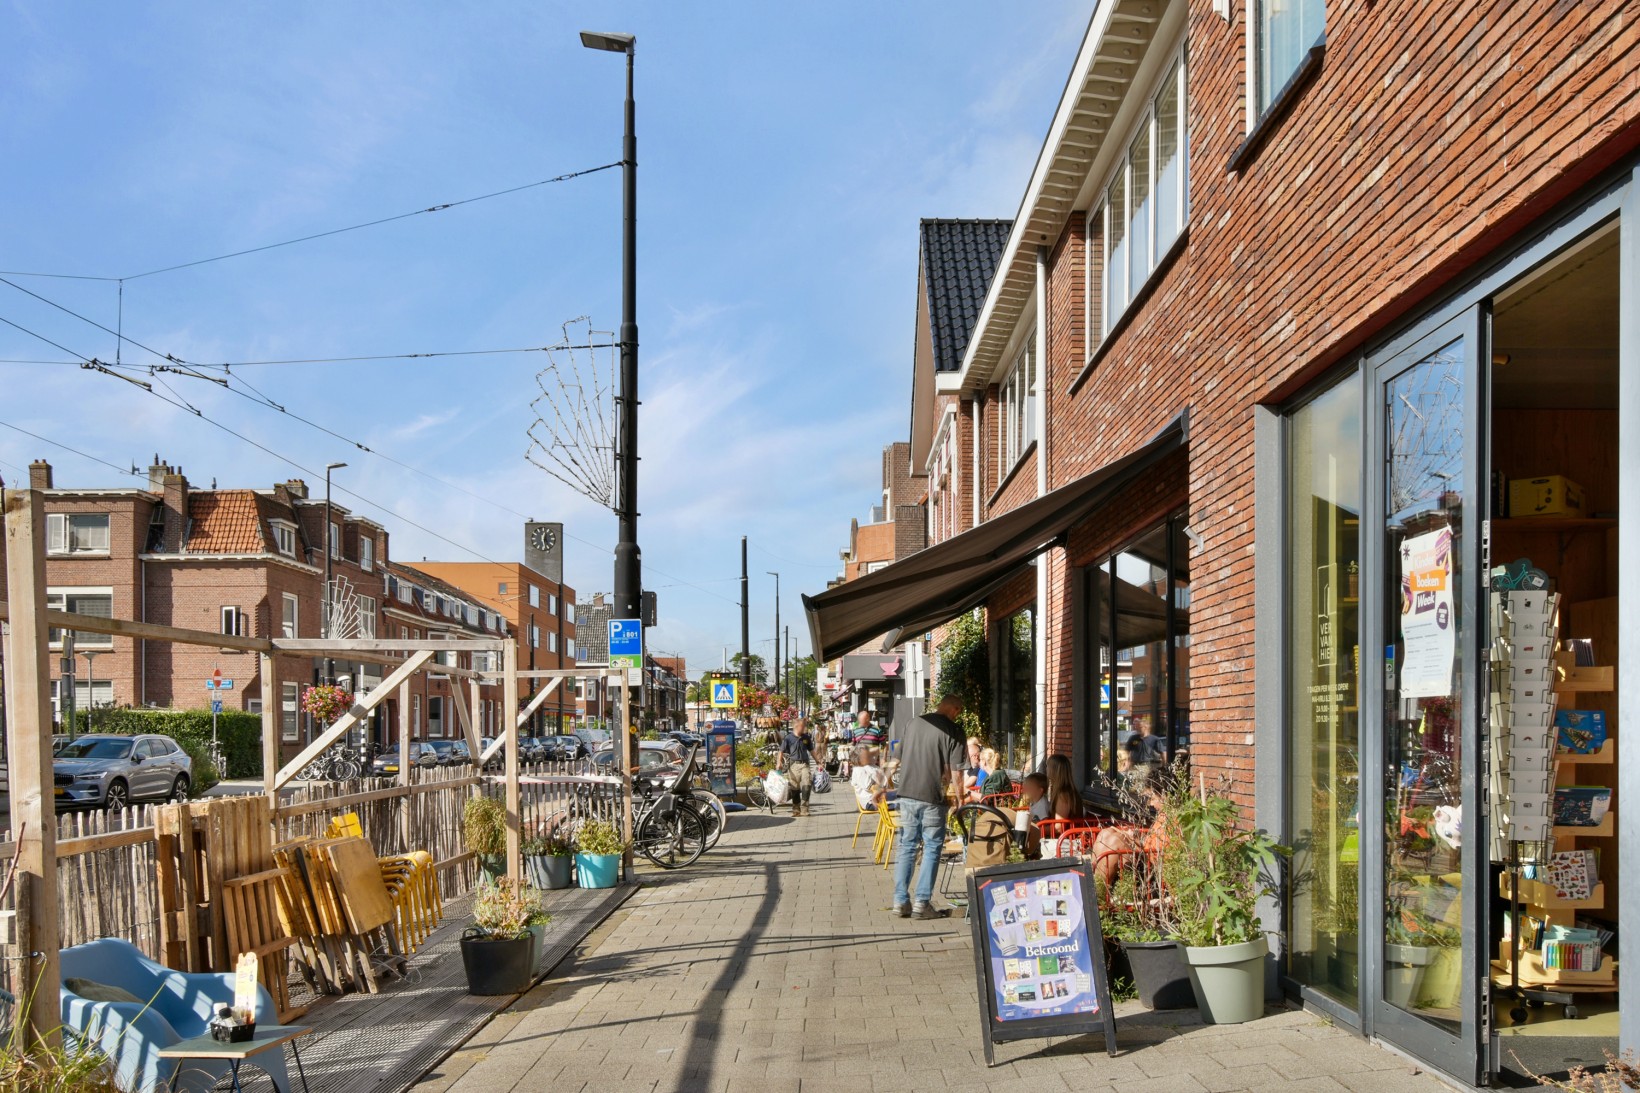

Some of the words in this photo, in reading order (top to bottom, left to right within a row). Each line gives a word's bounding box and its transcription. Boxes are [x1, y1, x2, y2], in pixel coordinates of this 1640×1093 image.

[1416, 574, 1440, 588] Boeken
[1417, 592, 1435, 608] Week
[611, 621, 623, 638] P
[1320, 622, 1332, 635] VER
[1320, 635, 1333, 648] VAN
[1320, 647, 1334, 660] HIER
[711, 757, 732, 767] 22,1
[1025, 940, 1079, 957] Bekroond
